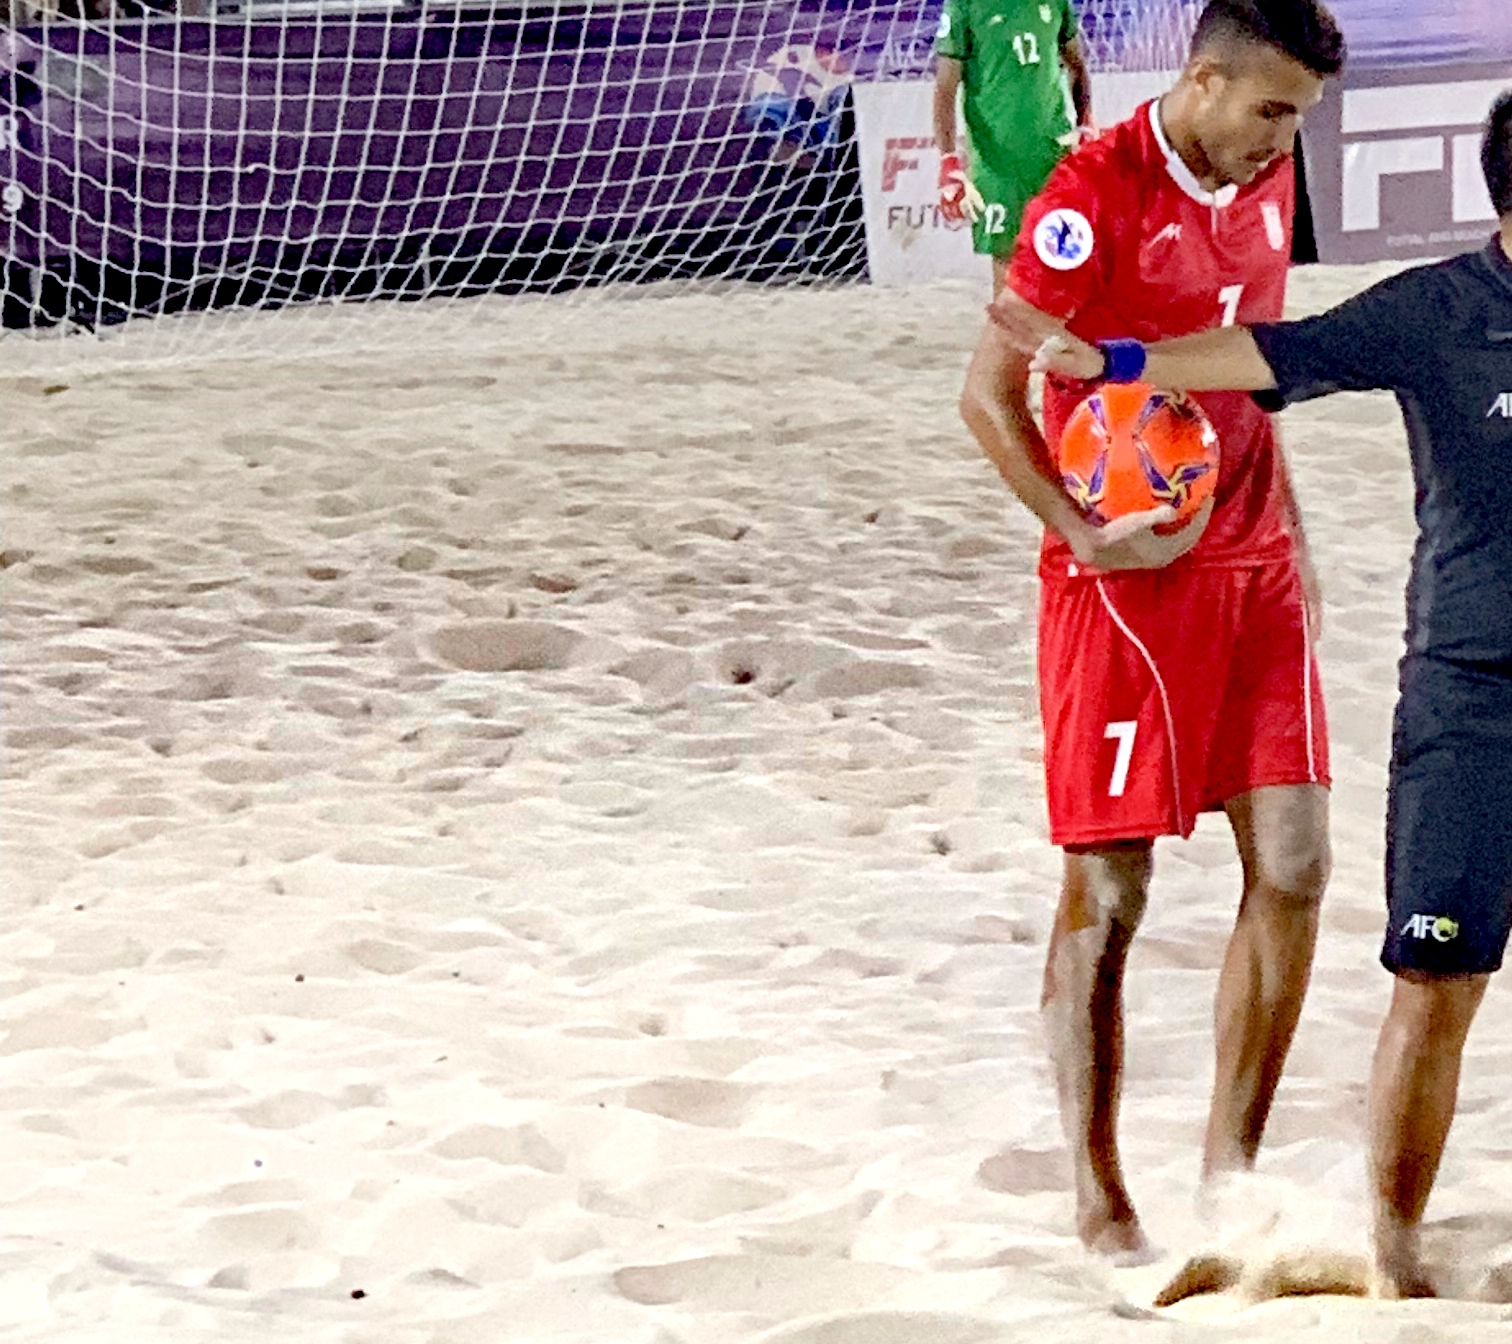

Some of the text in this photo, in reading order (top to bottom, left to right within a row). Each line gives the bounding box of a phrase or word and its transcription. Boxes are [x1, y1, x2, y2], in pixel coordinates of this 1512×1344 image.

[1012, 32, 1041, 66] 12
[984, 203, 1007, 234] 12
[1103, 720, 1138, 797] 7
[1400, 913, 1460, 943] AFC
